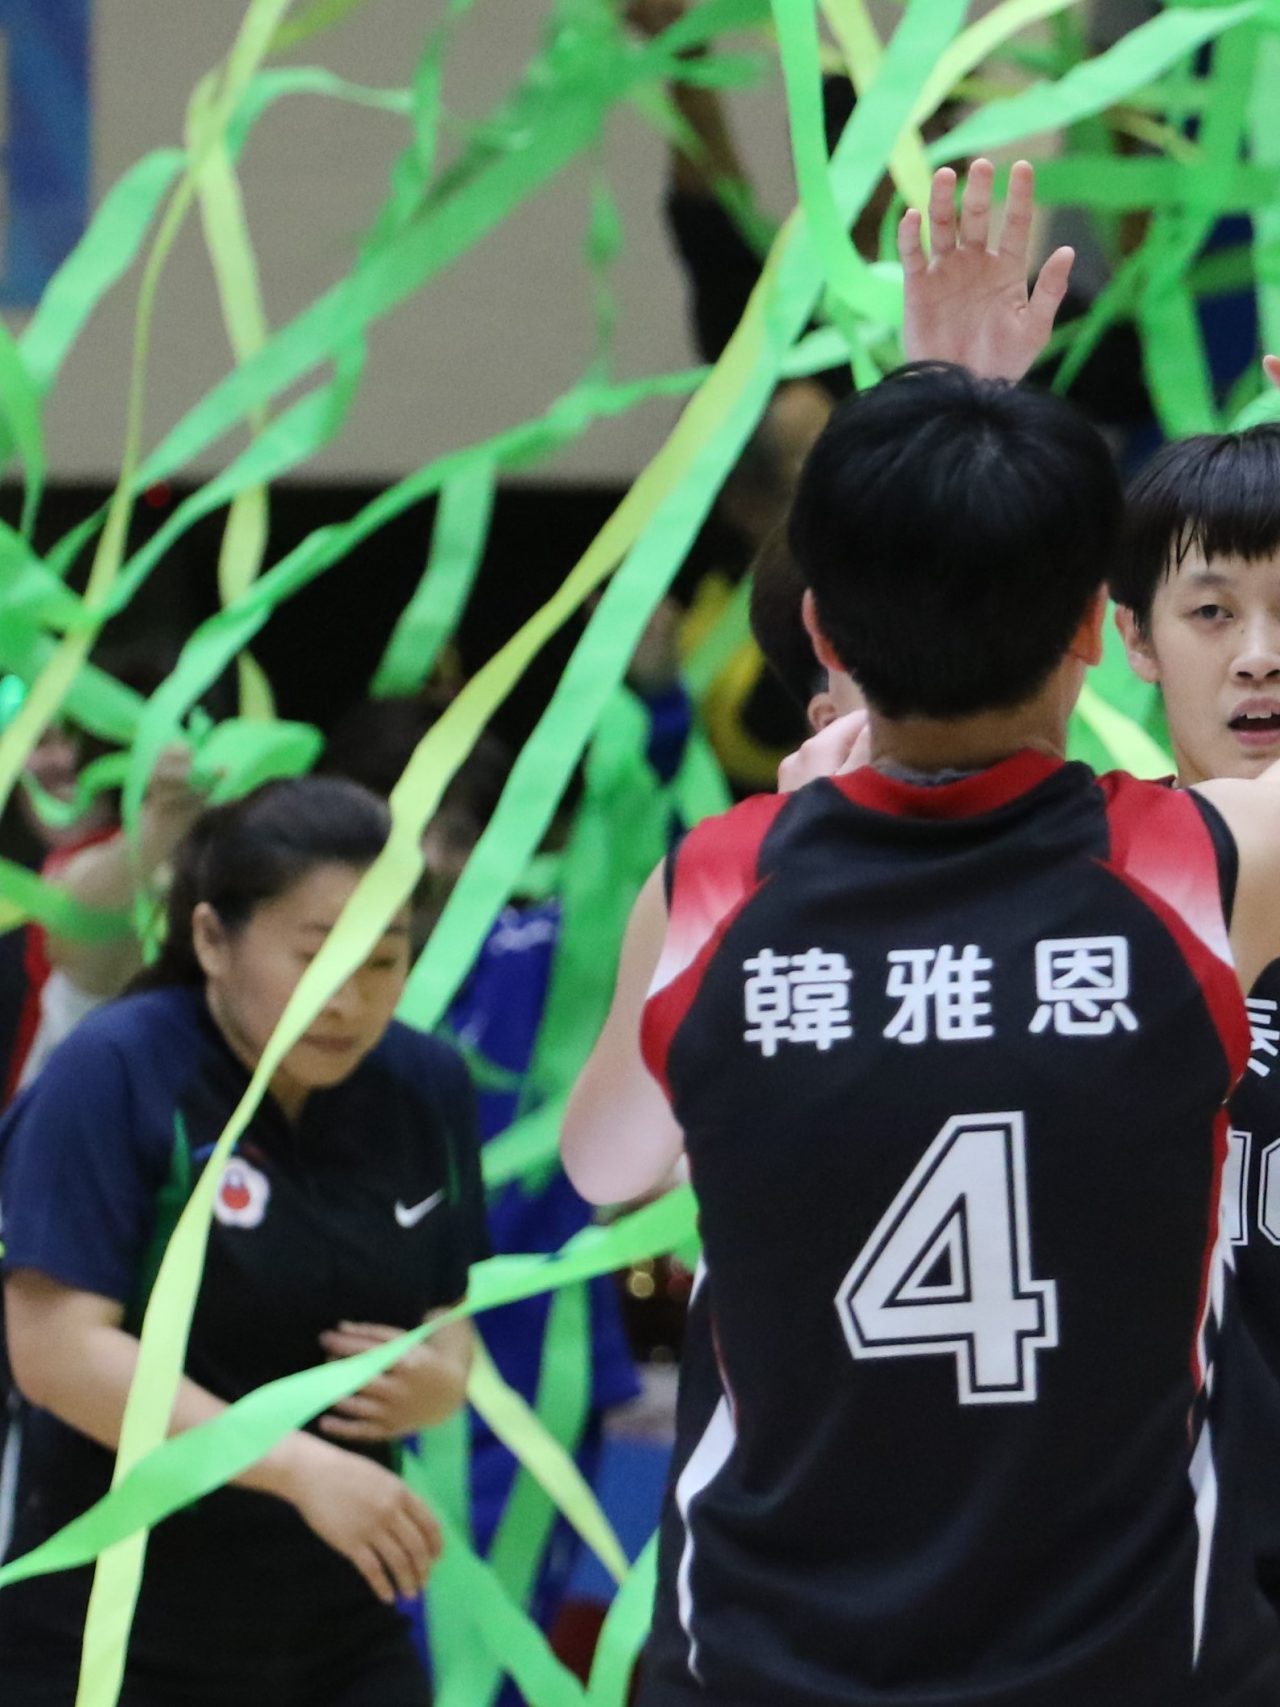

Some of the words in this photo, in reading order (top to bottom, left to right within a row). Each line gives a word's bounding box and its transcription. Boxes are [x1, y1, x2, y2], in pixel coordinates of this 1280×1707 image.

[743, 936, 1138, 1057] 韓雅恩
[834, 1110, 1058, 1405] 4
